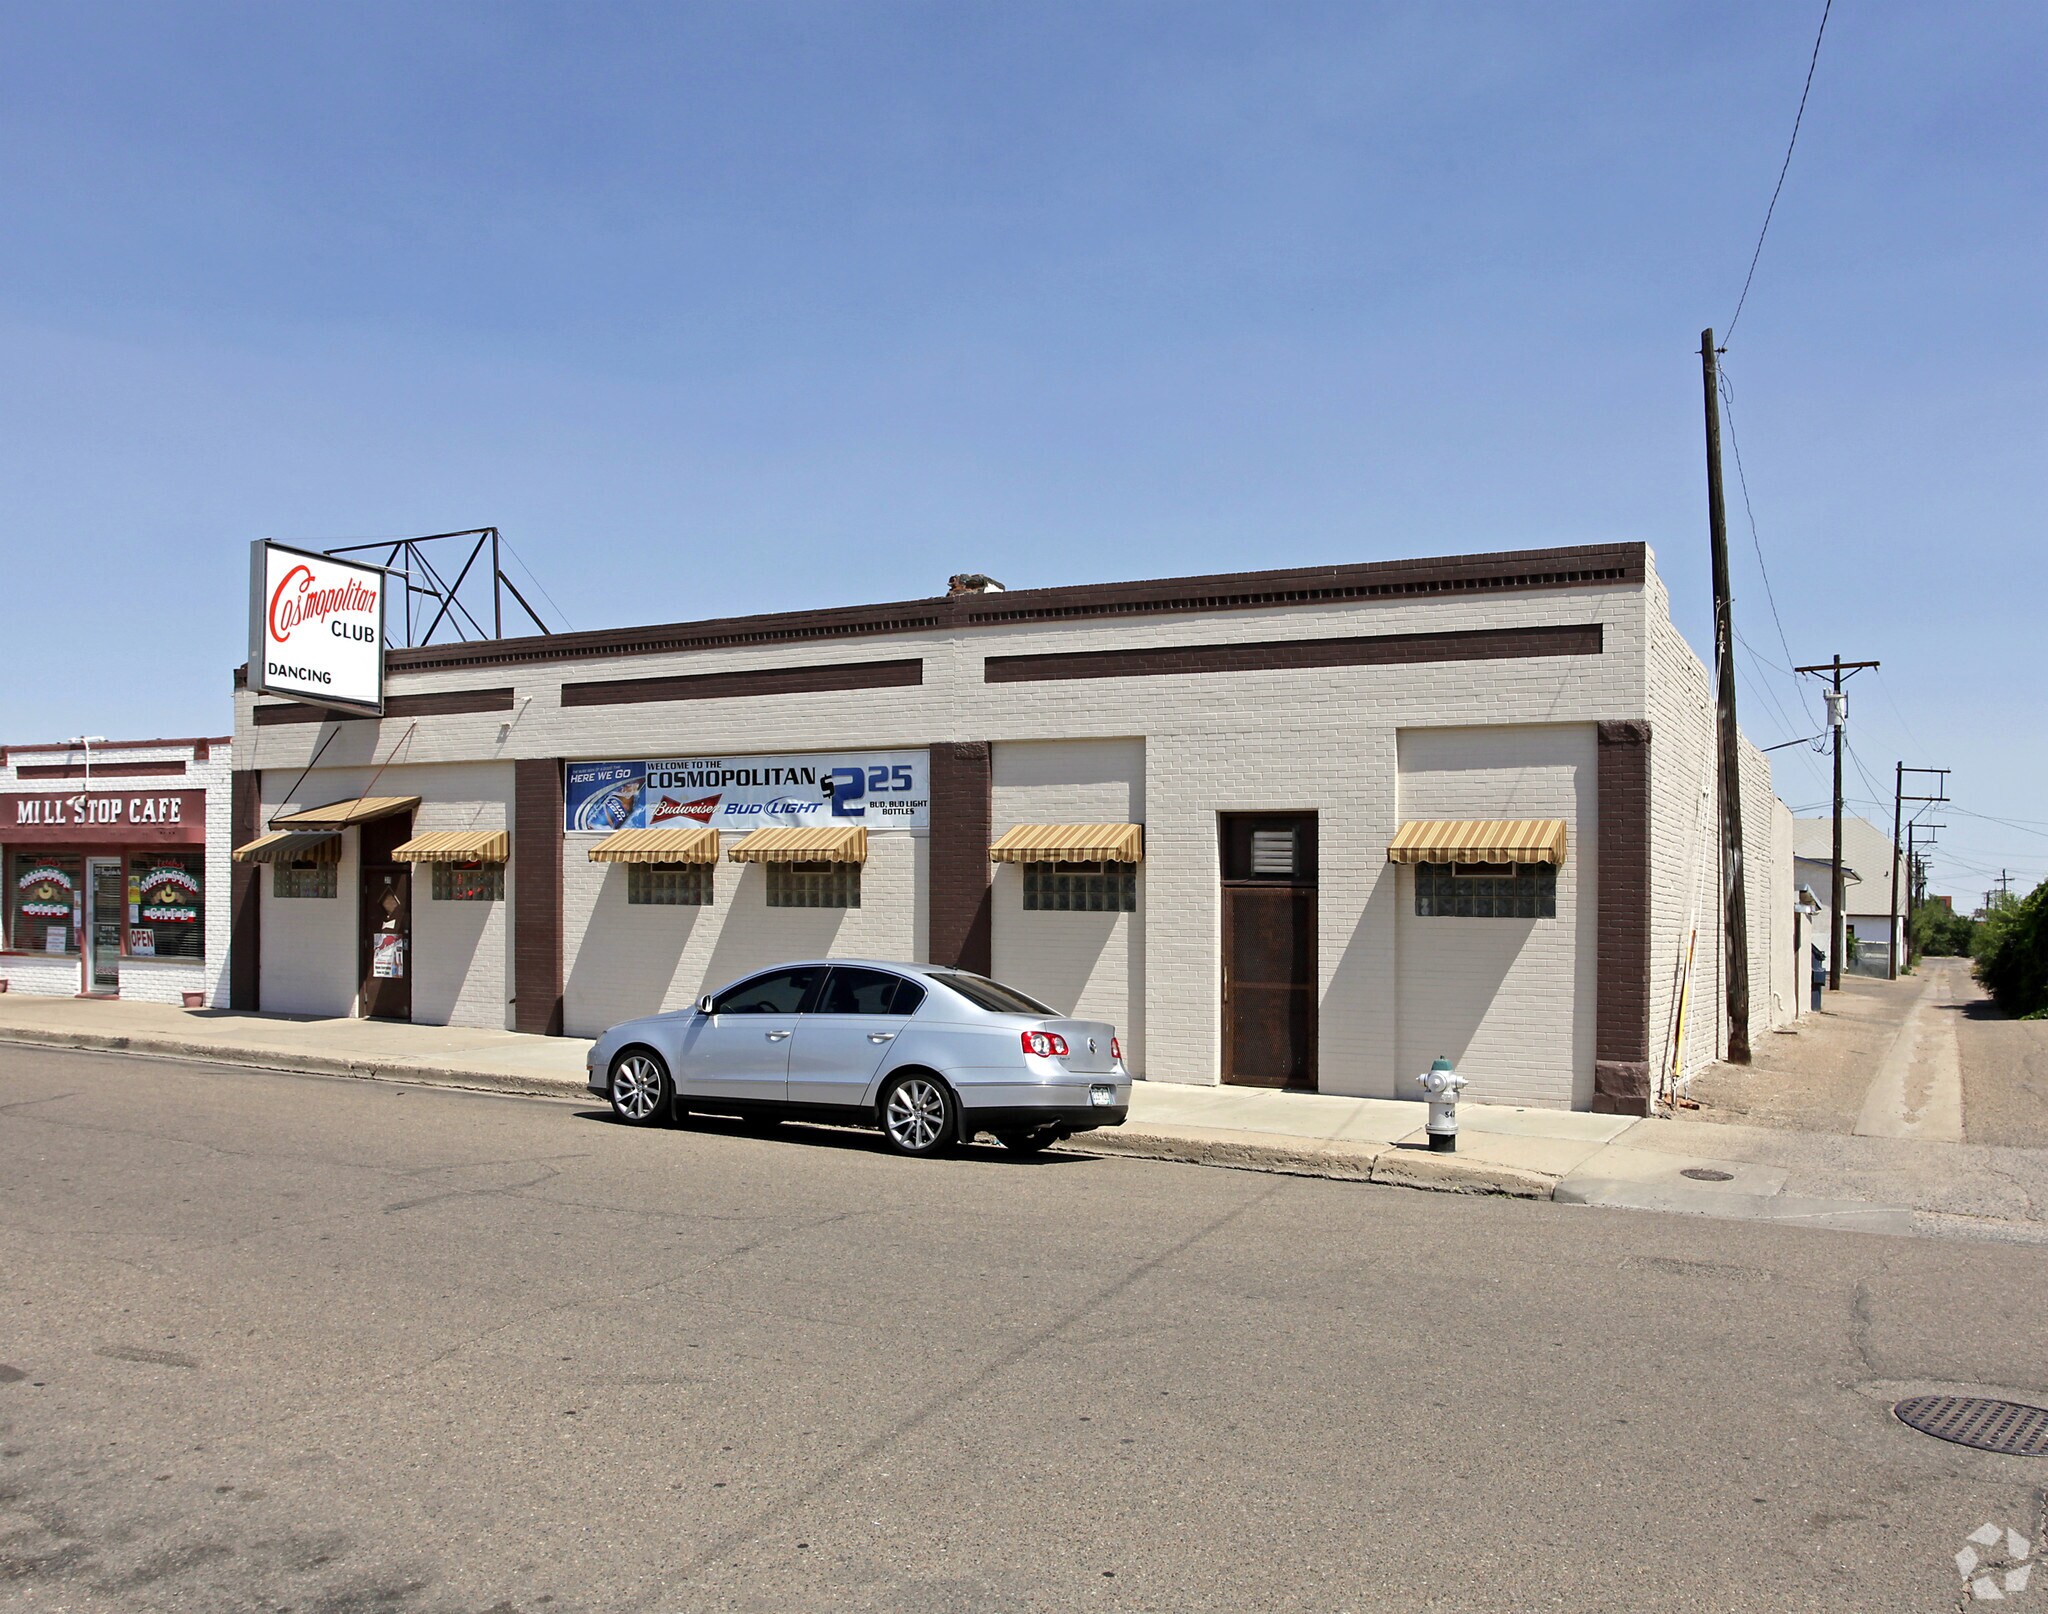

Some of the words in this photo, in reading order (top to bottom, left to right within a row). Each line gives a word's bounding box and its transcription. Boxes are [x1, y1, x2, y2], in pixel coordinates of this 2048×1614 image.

[269, 564, 377, 643] Cosmopolitan
[331, 620, 375, 643] CLUB
[268, 662, 332, 684] DANCING
[647, 761, 689, 770] WELCOME
[692, 761, 703, 769] TO
[705, 760, 722, 769] THE
[570, 772, 595, 783] HERE
[598, 771, 613, 780] WE
[615, 769, 631, 779] GO
[646, 767, 816, 789] COSMOPOLITAN
[16, 800, 66, 824] MILL
[73, 799, 122, 824] STOP
[129, 797, 182, 823] CAFE
[610, 799, 626, 818] BUD
[653, 800, 722, 817] Budweiser
[724, 803, 763, 815] BUD
[770, 803, 823, 815] LIGHT
[140, 869, 168, 893] MILL
[171, 870, 199, 893] STOP
[28, 903, 64, 916] CAFE
[150, 907, 188, 920] CAFE
[131, 930, 154, 947] OPEN
